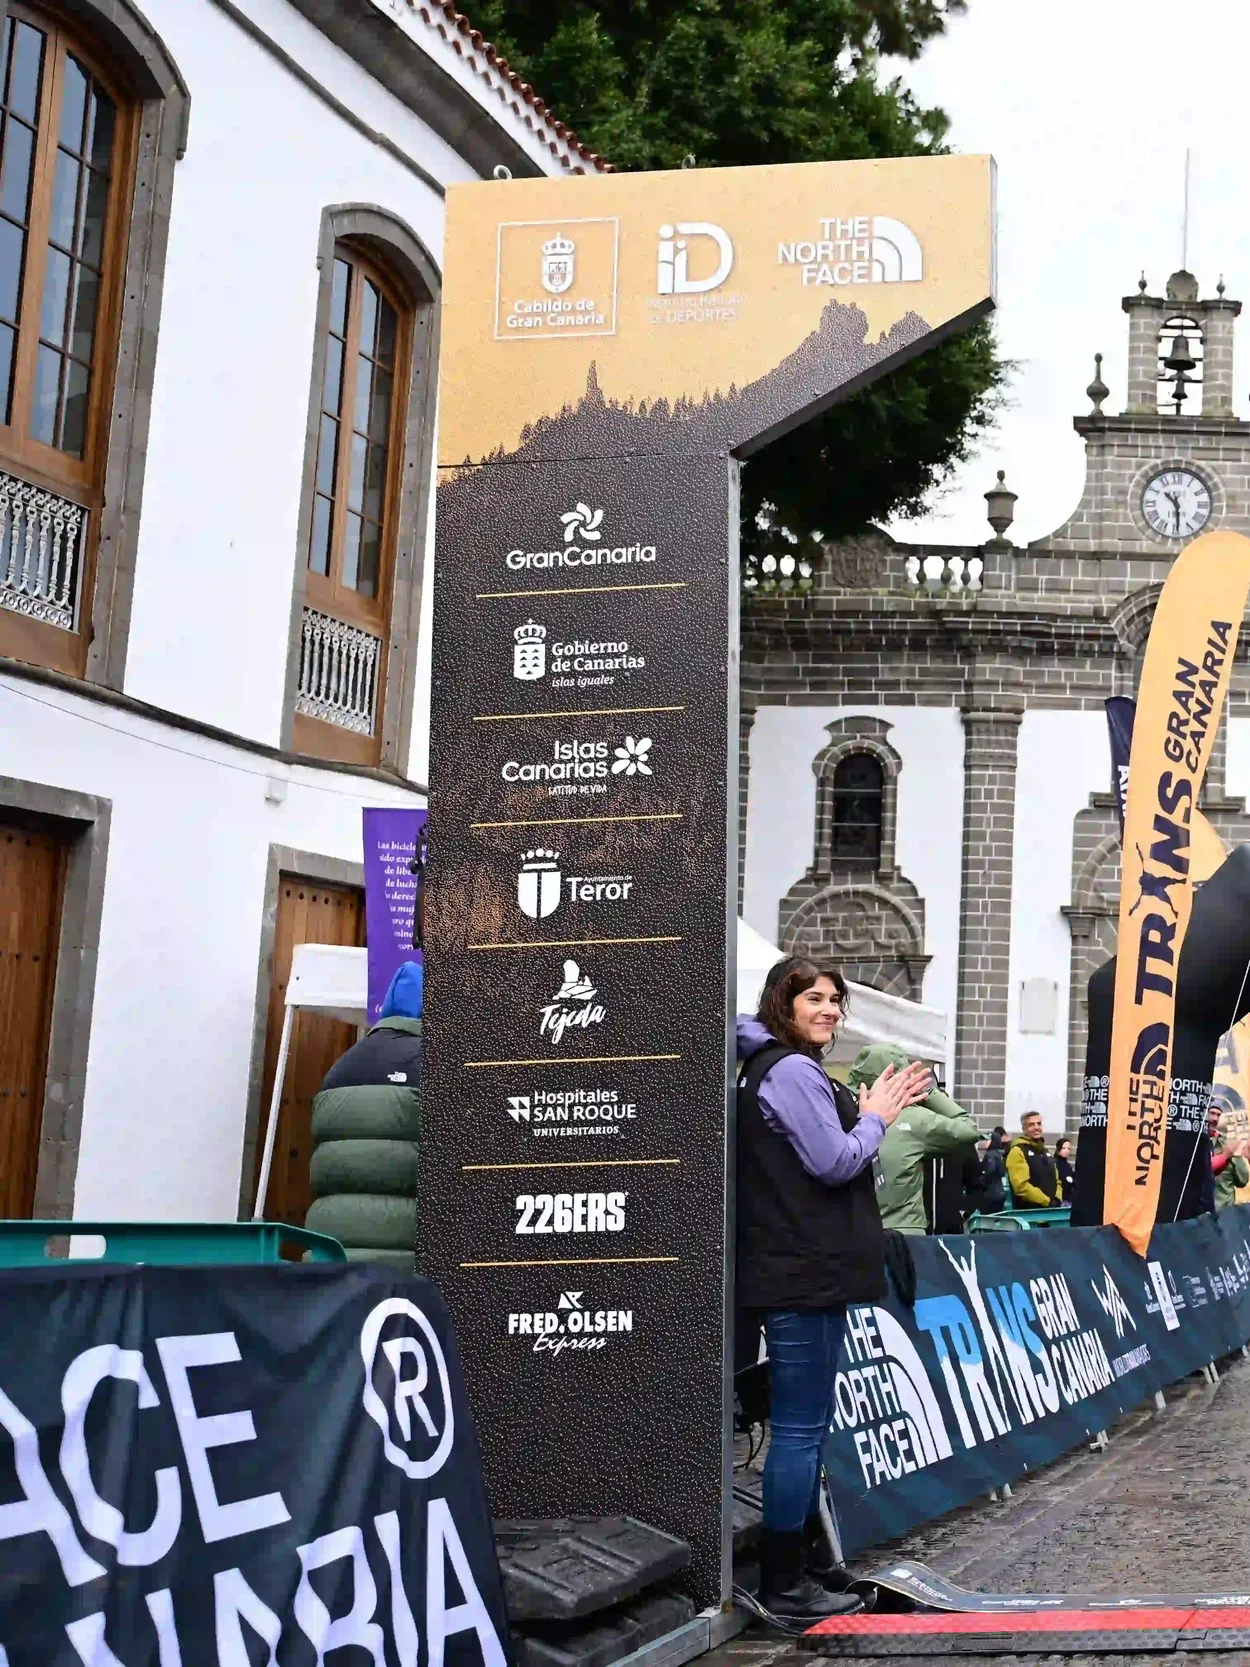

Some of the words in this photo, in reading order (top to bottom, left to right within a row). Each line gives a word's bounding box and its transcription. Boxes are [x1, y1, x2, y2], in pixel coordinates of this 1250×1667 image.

[819, 217, 869, 239] THE
[777, 241, 873, 265] NORTH
[802, 263, 872, 286] FACE
[514, 298, 572, 313] Cabildo
[576, 297, 595, 311] de
[506, 314, 542, 328] Gran
[547, 311, 605, 326] Canaria
[506, 542, 656, 569] GranCanaria
[551, 640, 628, 657] Gobierno
[551, 659, 571, 673] de
[573, 655, 645, 671] Canarias
[551, 676, 575, 687] islas
[577, 674, 615, 689] iguales
[1185, 620, 1232, 774] CANARIA
[1164, 656, 1200, 763] GRAN
[554, 740, 608, 760] Islas
[502, 759, 608, 782] Canarias
[566, 877, 633, 901] Teror
[1129, 771, 1193, 1006] TRANS
[539, 1003, 606, 1044] Tejeda
[534, 1089, 618, 1106] Hospitales
[1089, 1089, 1108, 1100] THE
[534, 1107, 569, 1122] SAN
[573, 1104, 636, 1121] ROQUE
[1180, 1105, 1200, 1119] THE
[533, 1126, 619, 1137] UNIVERSITARIOS
[1135, 1079, 1157, 1187] NORTH
[516, 1192, 626, 1234] 226ERS
[1030, 1272, 1080, 1340] GRAN
[533, 1331, 606, 1356] Express
[913, 1239, 1060, 1449] TRANS
[1050, 1328, 1115, 1405] CANARIA
[828, 1362, 900, 1434] NORTH
[853, 1418, 917, 1489] FACE
